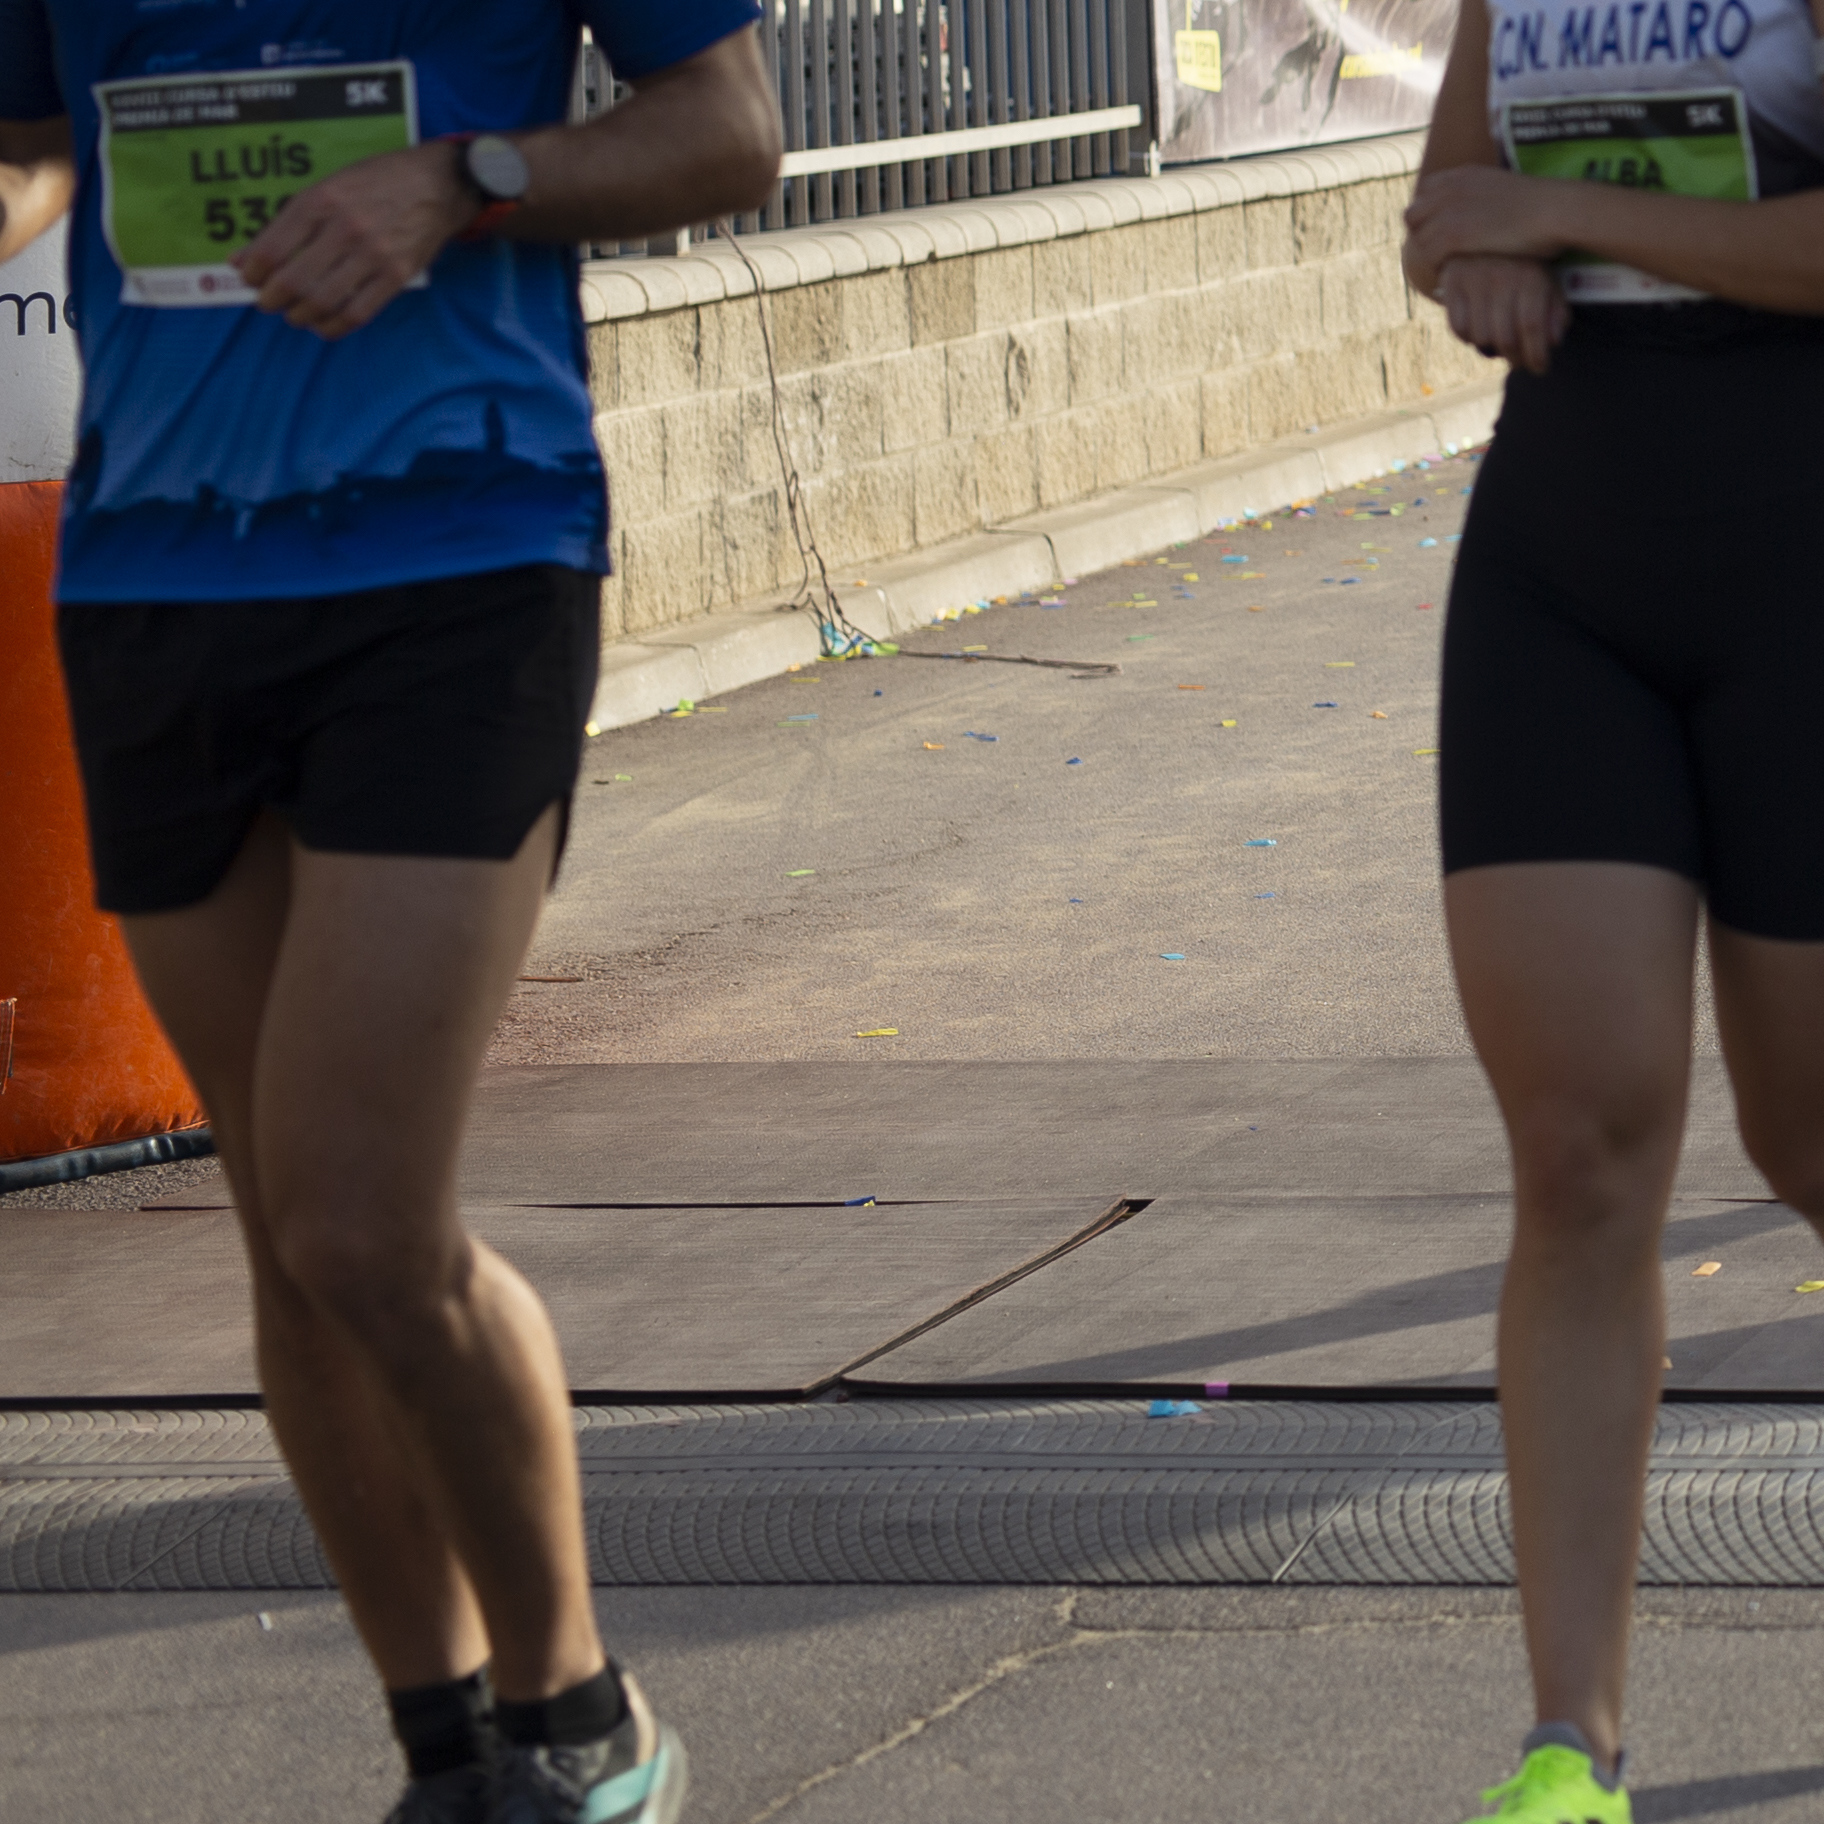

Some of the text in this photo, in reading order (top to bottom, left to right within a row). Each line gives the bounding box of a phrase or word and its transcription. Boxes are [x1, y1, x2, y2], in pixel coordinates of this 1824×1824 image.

[345, 80, 388, 106] 5K
[1685, 104, 1724, 126] 5K
[190, 135, 314, 183] LLUÍS
[206, 196, 292, 242] 53
